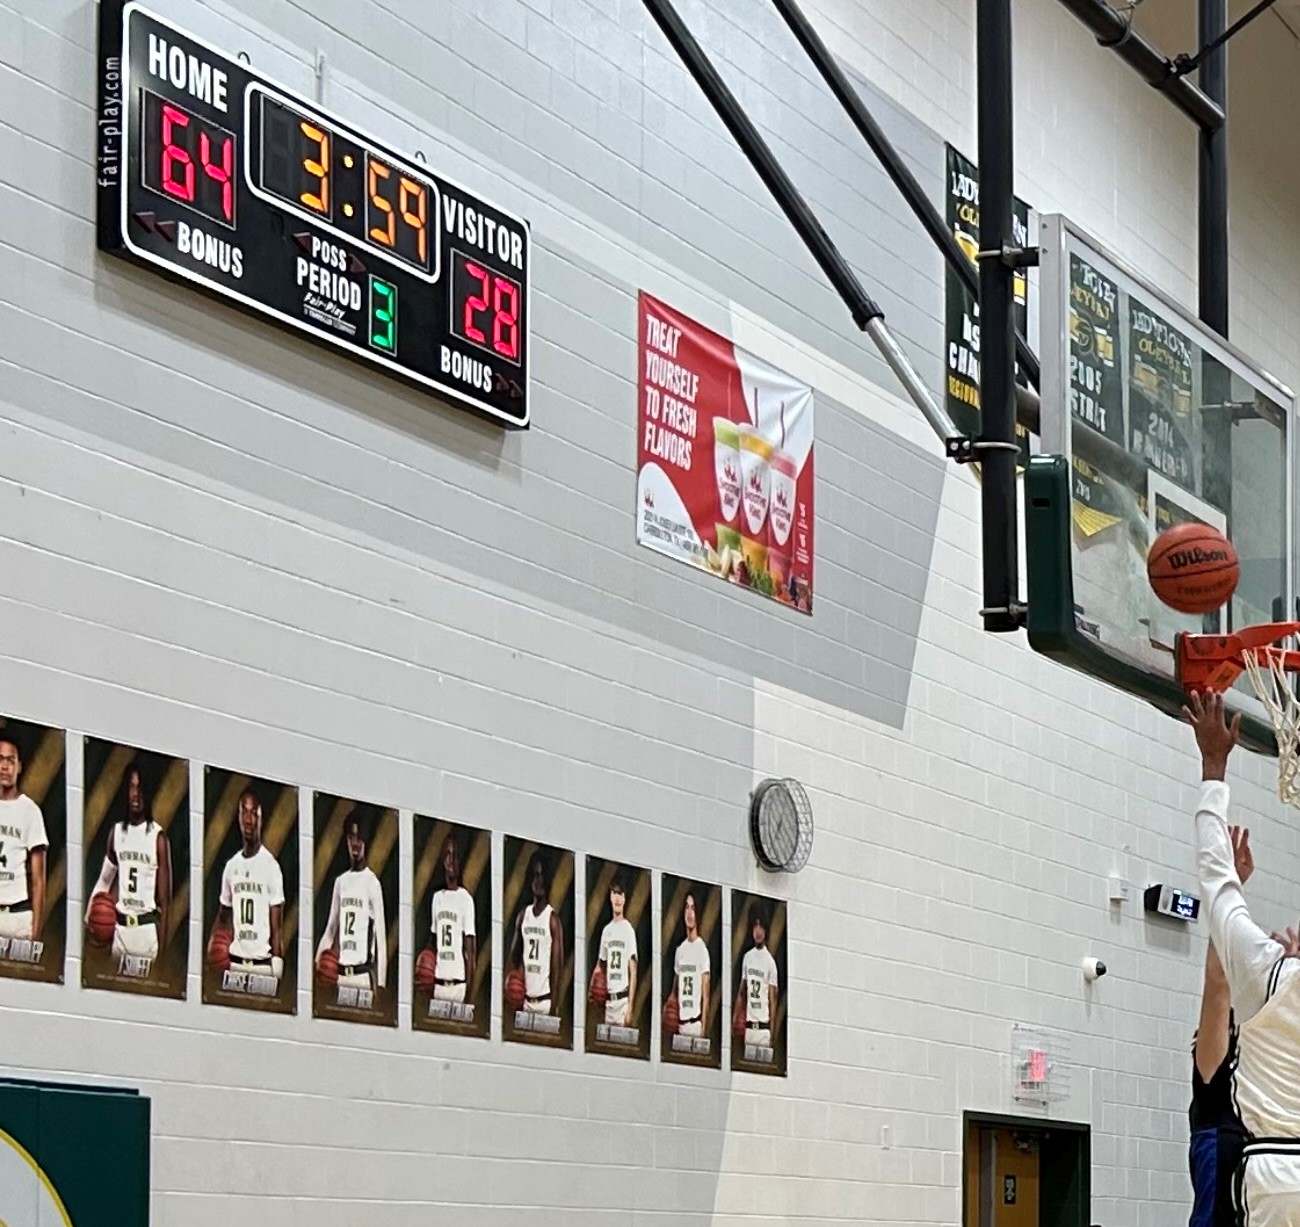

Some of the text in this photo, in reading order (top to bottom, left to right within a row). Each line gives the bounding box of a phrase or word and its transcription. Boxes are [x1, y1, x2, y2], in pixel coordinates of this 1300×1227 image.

[148, 33, 228, 113] HOME
[98, 56, 120, 187] fair-play.com
[161, 105, 232, 221] 64
[300, 121, 427, 263] 3:59
[176, 220, 243, 279] BONUS
[311, 235, 347, 272] POSS
[443, 193, 524, 270] VISITOR
[297, 256, 361, 312] PERIOD
[373, 279, 393, 349] 3
[464, 261, 518, 359] 28
[646, 314, 681, 359] TREAT
[440, 345, 493, 393] BONUS
[645, 351, 699, 404] YOURSELF
[645, 387, 698, 440] TO FRESH
[644, 421, 692, 471] FLAVORS
[128, 867, 138, 893] 5
[239, 897, 255, 925] 10
[343, 911, 357, 936] 12
[441, 923, 453, 948] 15
[528, 938, 541, 962] 21
